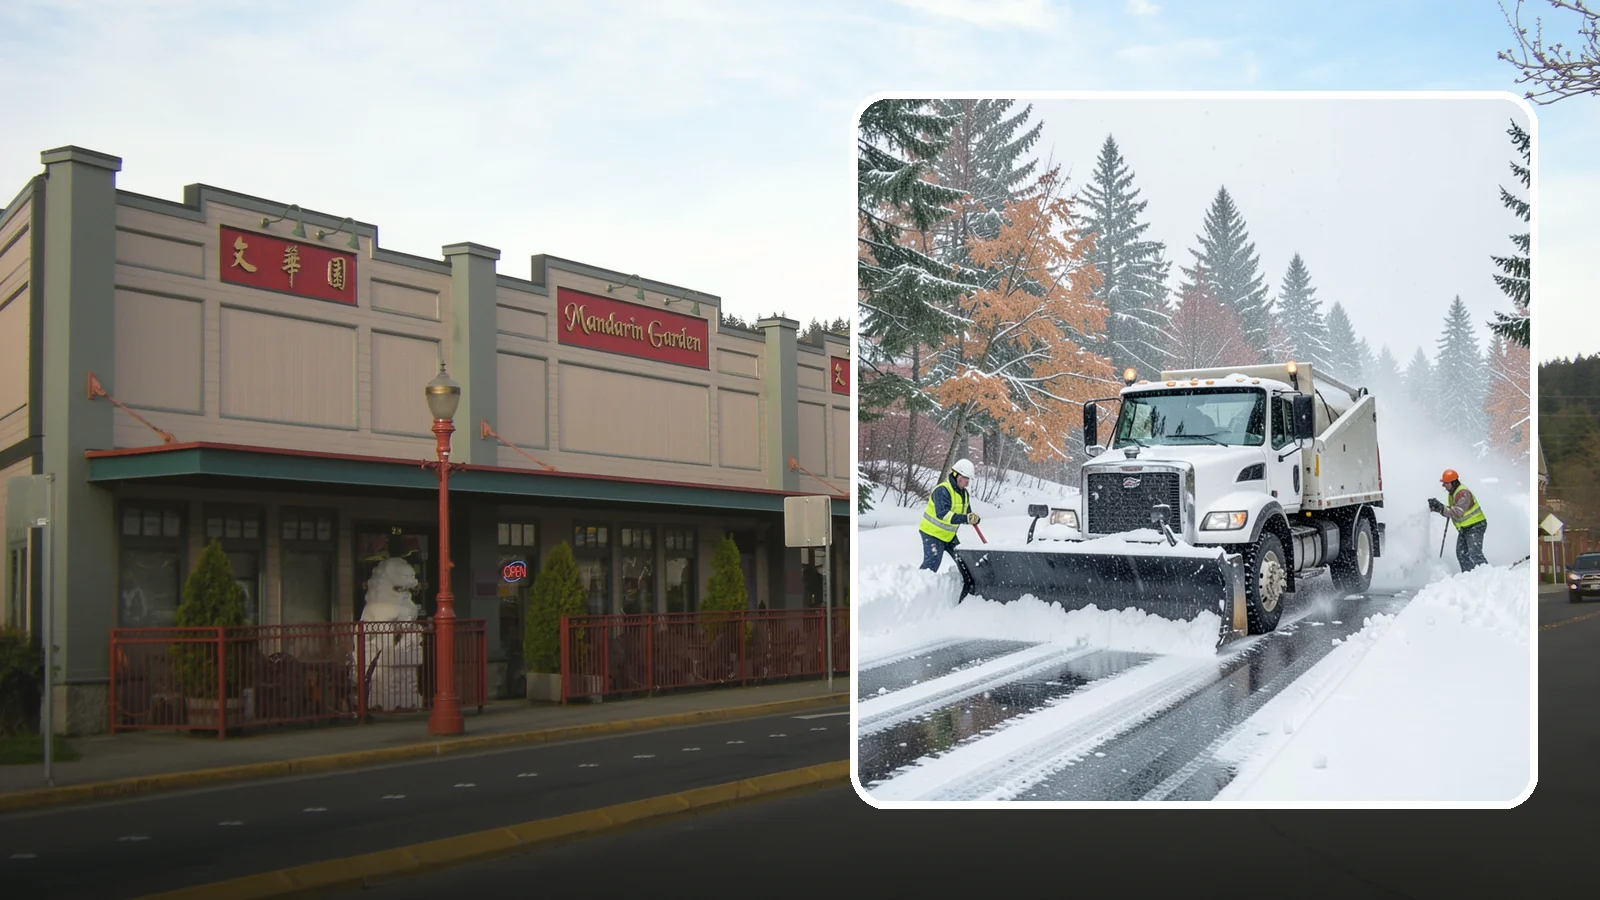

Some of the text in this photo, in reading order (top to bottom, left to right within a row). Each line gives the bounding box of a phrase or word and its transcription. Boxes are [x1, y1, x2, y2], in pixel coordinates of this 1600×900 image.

[230, 235, 346, 291] 文華園
[564, 302, 702, 352] Mandarin Garden
[834, 363, 846, 386] 文
[503, 565, 527, 578] OPEN
